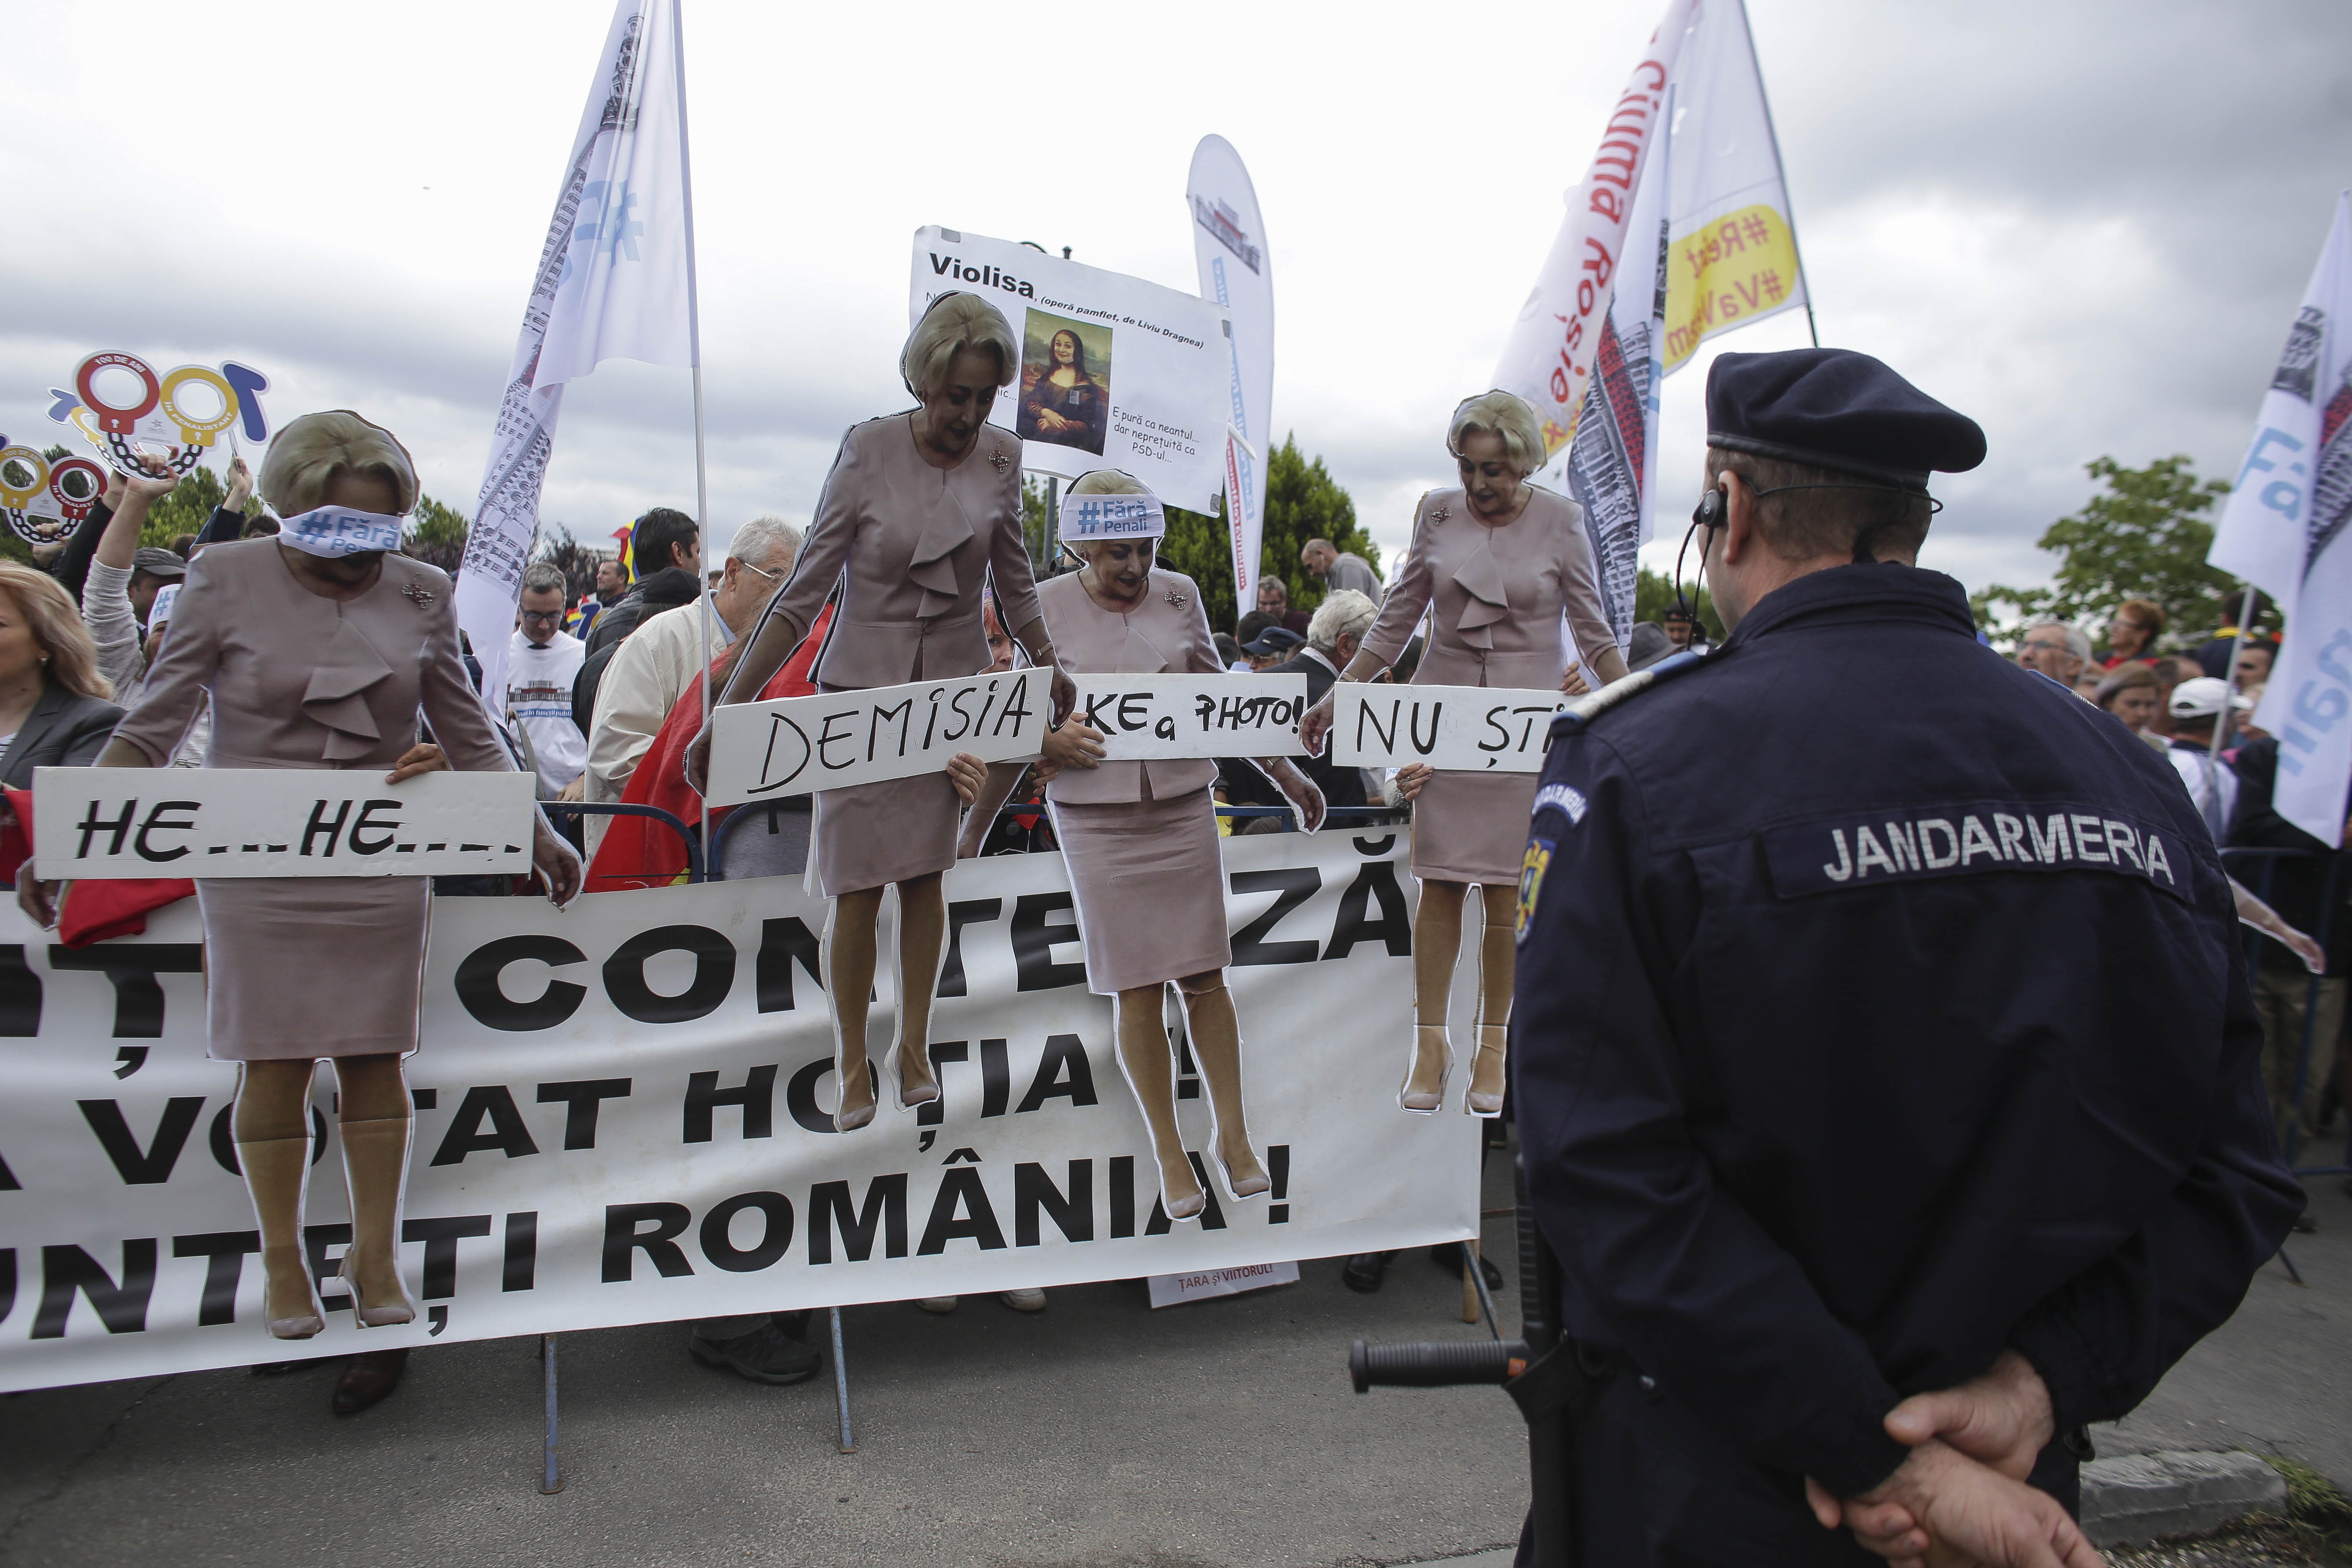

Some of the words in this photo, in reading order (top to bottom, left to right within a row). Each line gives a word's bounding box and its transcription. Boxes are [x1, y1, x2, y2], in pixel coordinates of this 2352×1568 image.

[1040, 296, 1074, 311] (operă
[1075, 307, 1119, 322] pamflet,
[1123, 315, 1135, 325] de
[1137, 320, 1161, 333] Liviu
[1162, 329, 1204, 349] Dragnea)
[94, 355, 113, 365] 100
[114, 355, 129, 364] DE
[128, 360, 147, 373] ANI
[1113, 406, 1120, 417] E
[1121, 411, 1143, 425] pură
[1145, 420, 1156, 429] ca
[1158, 423, 1199, 443] neantul...
[1114, 422, 1130, 435] dar
[1131, 429, 1183, 451] neprețuită
[1184, 446, 1195, 455] ca
[1132, 442, 1172, 463] PSD-ul...
[295, 512, 399, 549] #Fără
[1078, 501, 1147, 534] #Fără
[1104, 519, 1147, 533] Penali
[1085, 692, 1154, 736] KE
[1195, 694, 1304, 734] PHOTO!
[1357, 698, 1442, 756] NU
[1478, 703, 1565, 768] ȘTI
[1823, 812, 2175, 886] JANDARMERIA
[454, 834, 1411, 1032] CONTEZĂ
[76, 1077, 632, 1185] VOAT
[0, 1211, 539, 1340] NTEȚI
[601, 1147, 1227, 1283] ROMÂNIA
[1178, 1275, 1210, 1292] ȚARA
[1212, 1272, 1220, 1286] și
[1221, 1263, 1273, 1281] VIITORUL!
